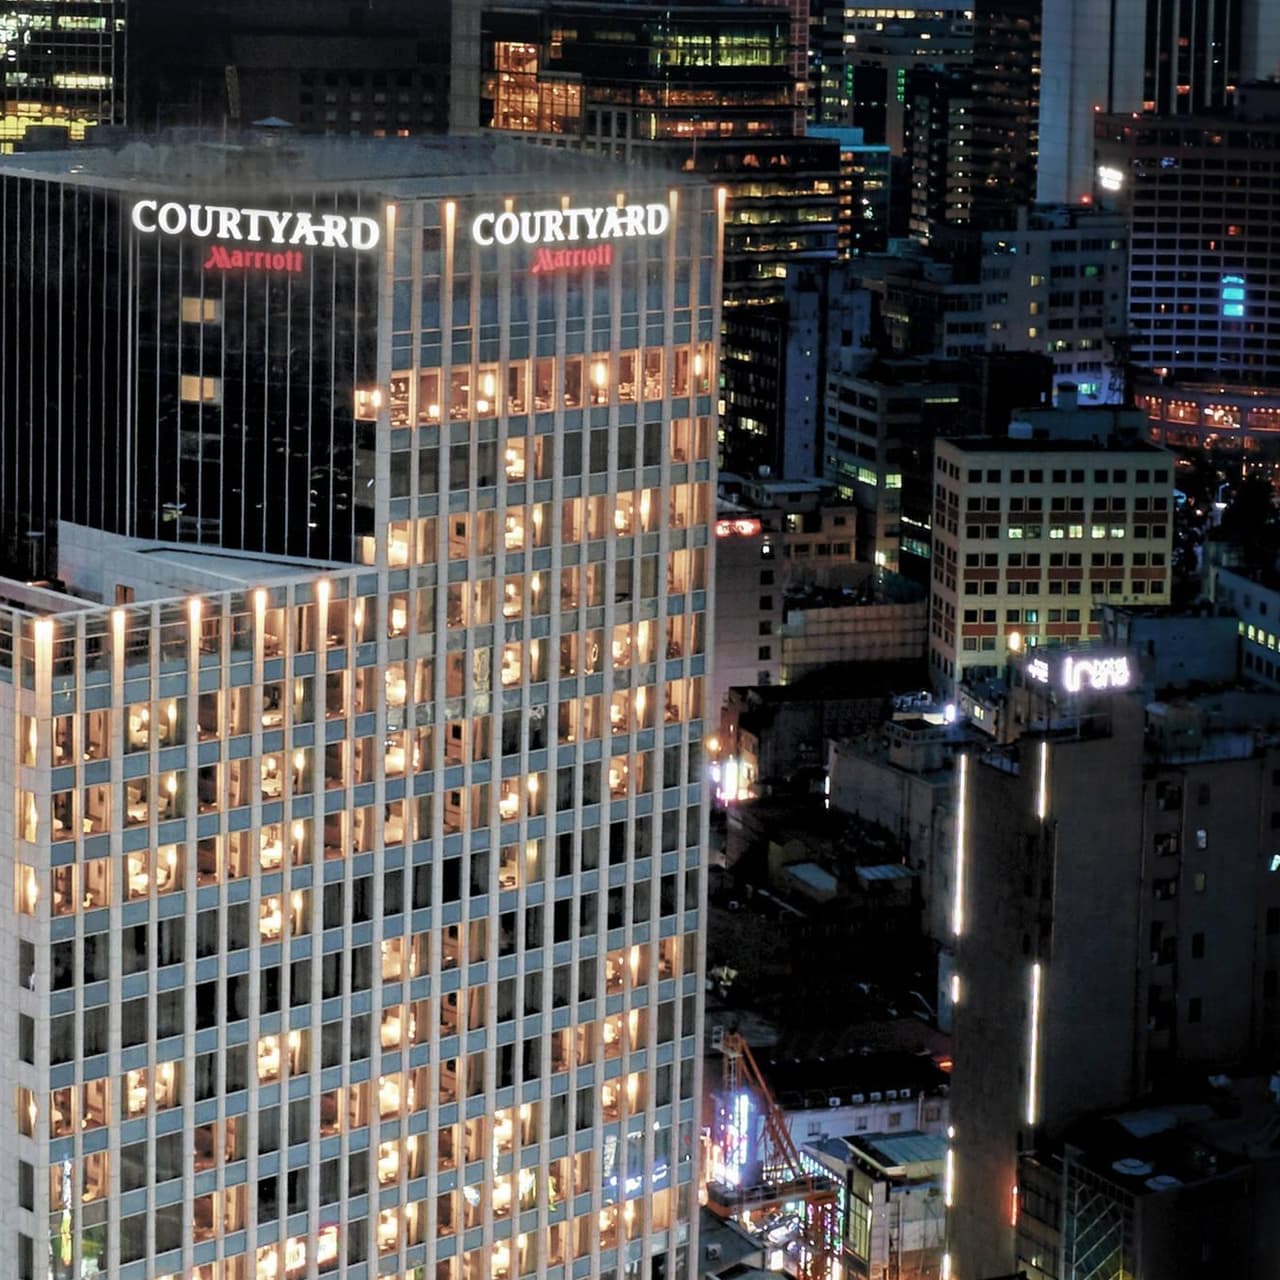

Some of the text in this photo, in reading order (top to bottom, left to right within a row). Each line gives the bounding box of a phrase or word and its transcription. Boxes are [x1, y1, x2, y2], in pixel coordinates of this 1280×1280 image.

[131, 199, 381, 251] COURTYARD
[472, 202, 670, 246] COURTYARD
[204, 245, 303, 273] Marriott
[531, 244, 613, 274] Marriott
